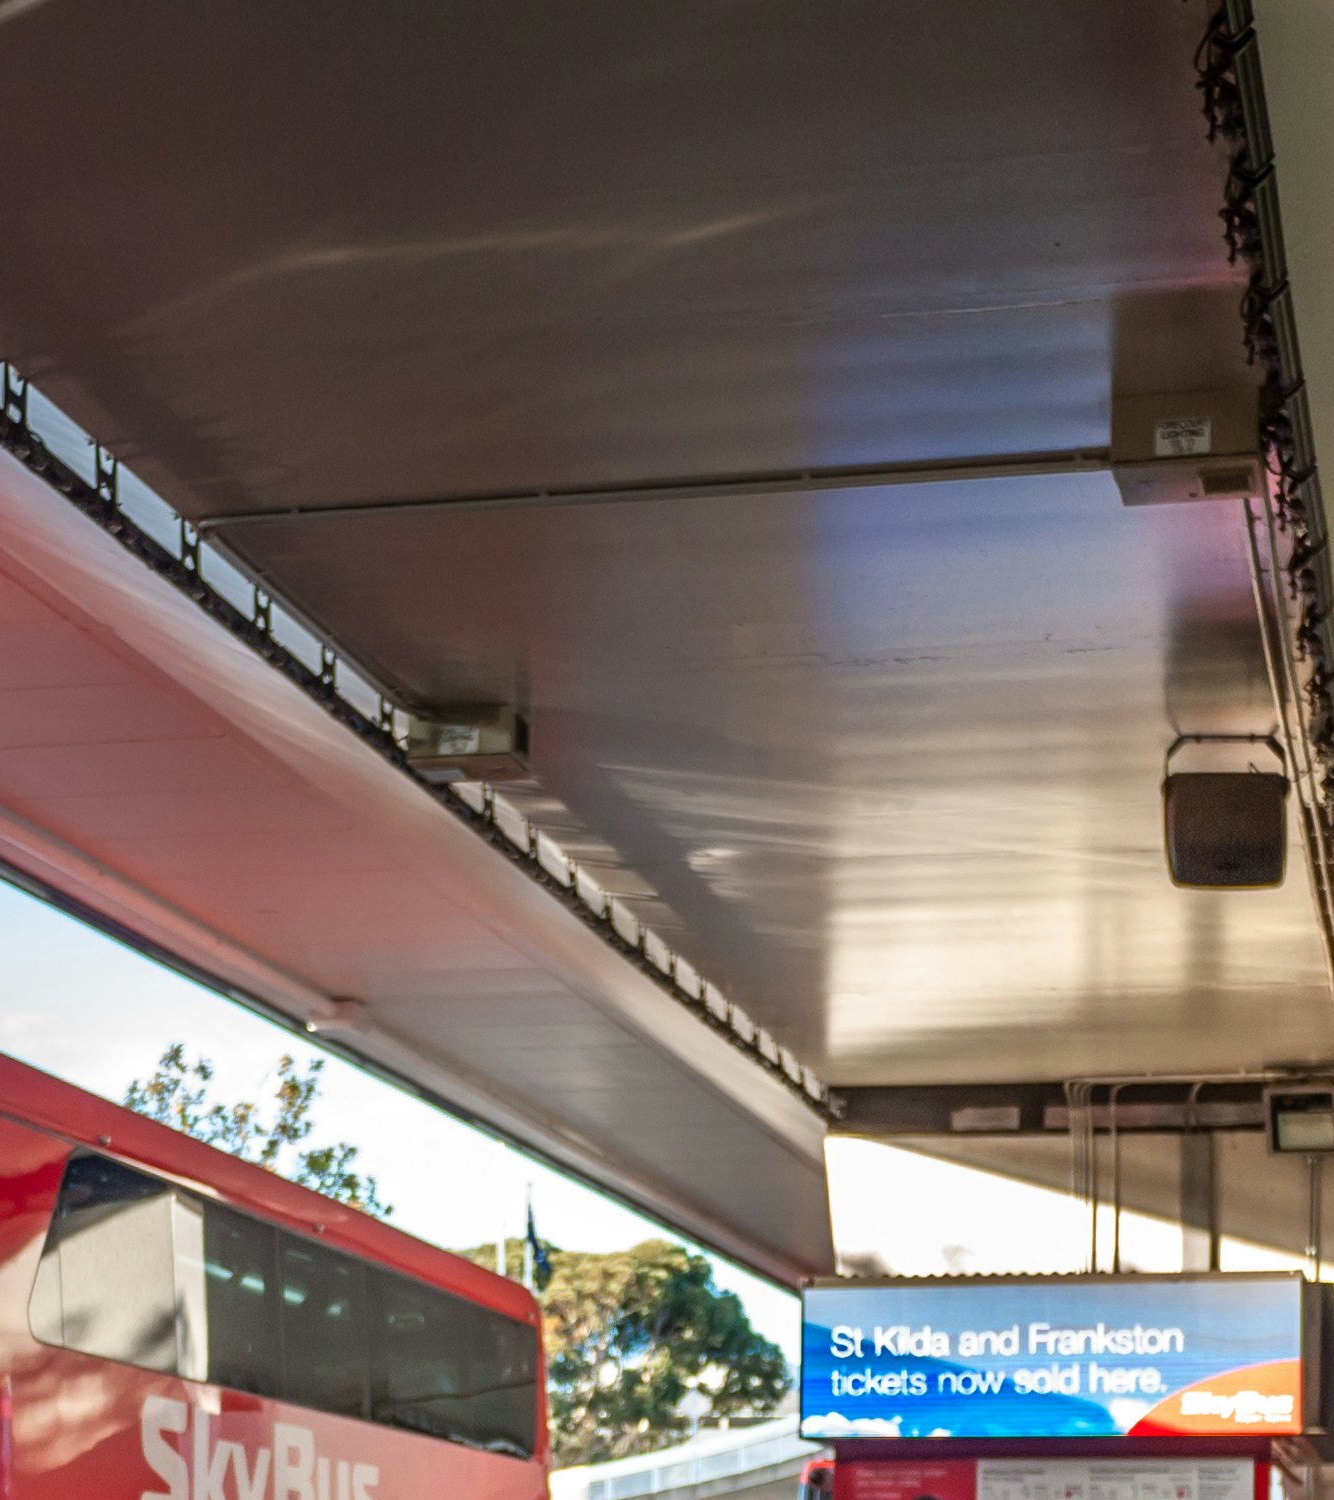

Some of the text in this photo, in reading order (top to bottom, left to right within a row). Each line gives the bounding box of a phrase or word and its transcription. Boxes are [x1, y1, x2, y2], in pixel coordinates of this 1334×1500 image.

[830, 1322, 1186, 1359] St Kilda and Frankston
[831, 1363, 1168, 1396] tickets now sold here.
